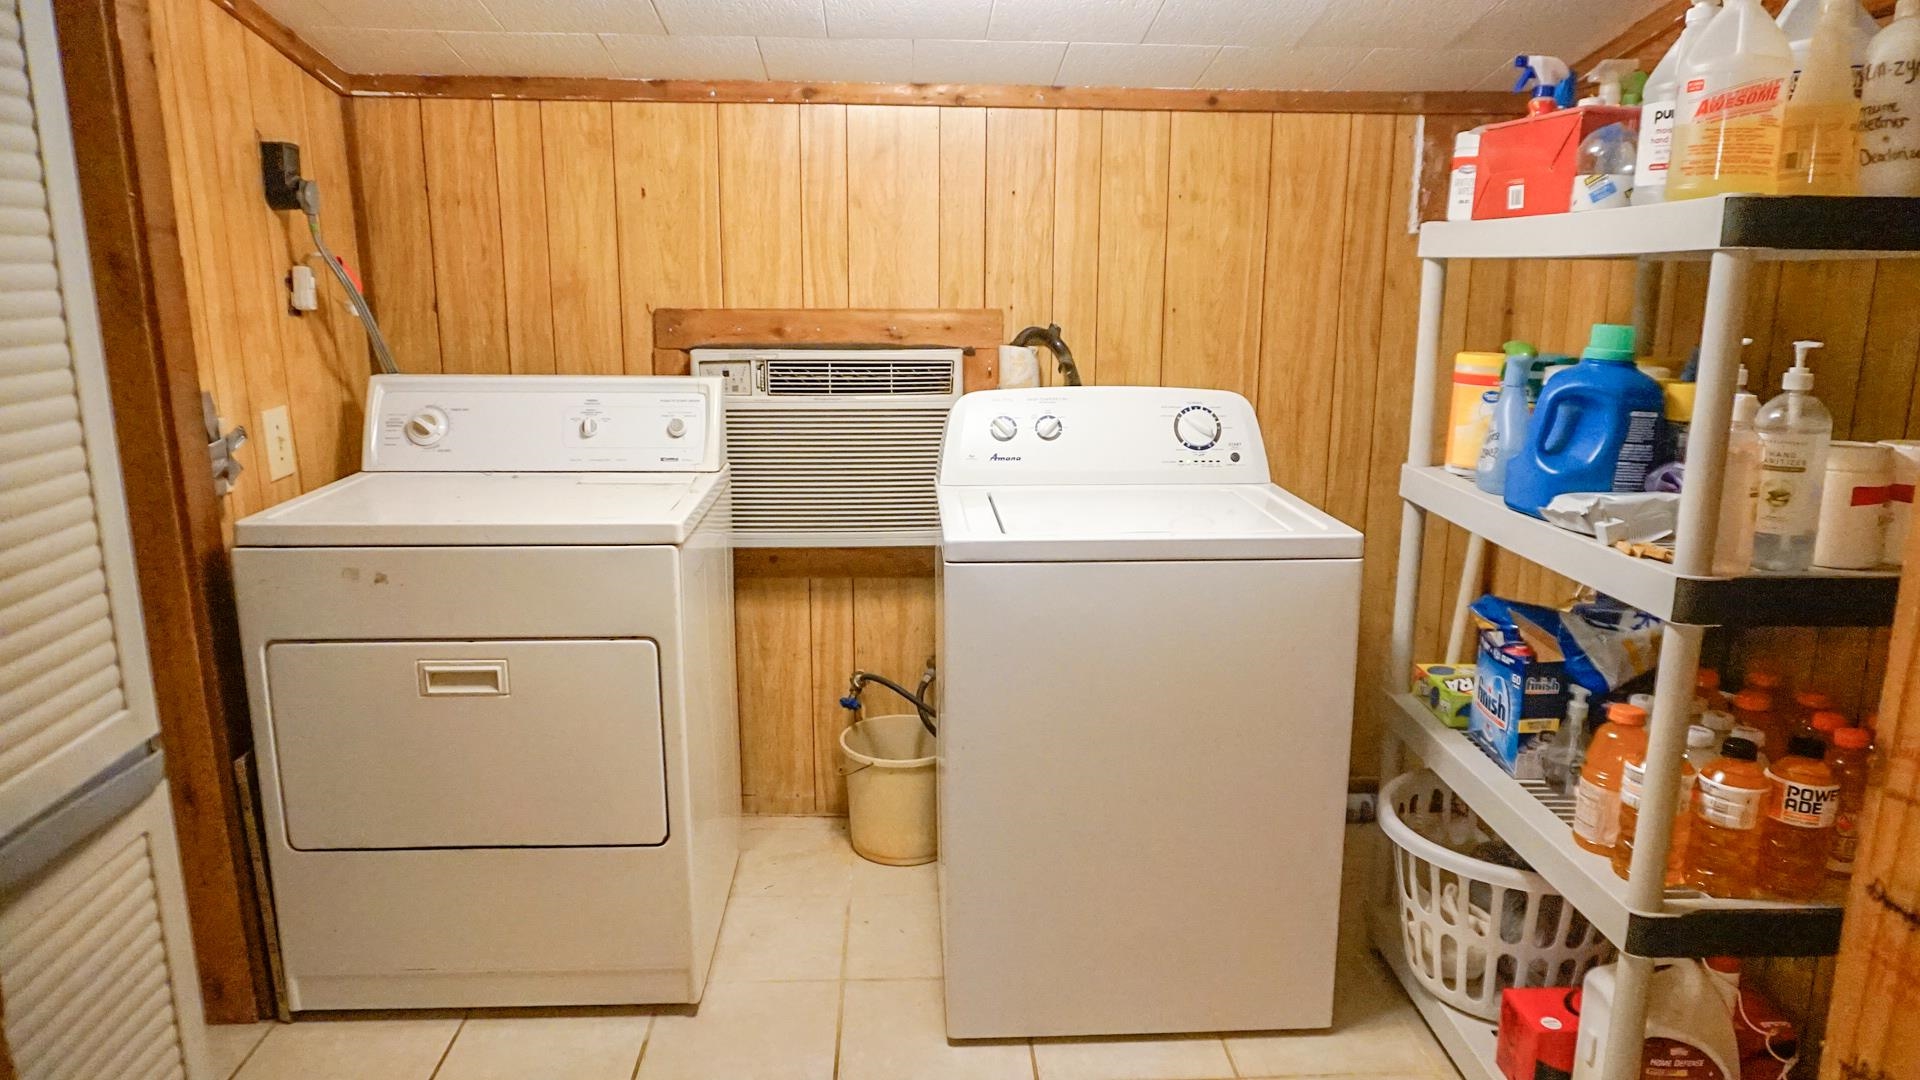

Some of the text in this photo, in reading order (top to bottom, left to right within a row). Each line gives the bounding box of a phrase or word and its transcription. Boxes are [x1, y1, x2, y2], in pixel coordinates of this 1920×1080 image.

[1694, 84, 1781, 117] AWESOME
[990, 453, 1022, 461] Amana
[1769, 451, 1797, 459] HAND
[1764, 459, 1807, 467] ANITIZER
[1526, 677, 1560, 691] finish
[1478, 675, 1506, 721] finish
[1787, 785, 1841, 802] POWE
[1785, 800, 1823, 814] ADE
[1650, 1058, 1705, 1067] HOME DEFENSE
